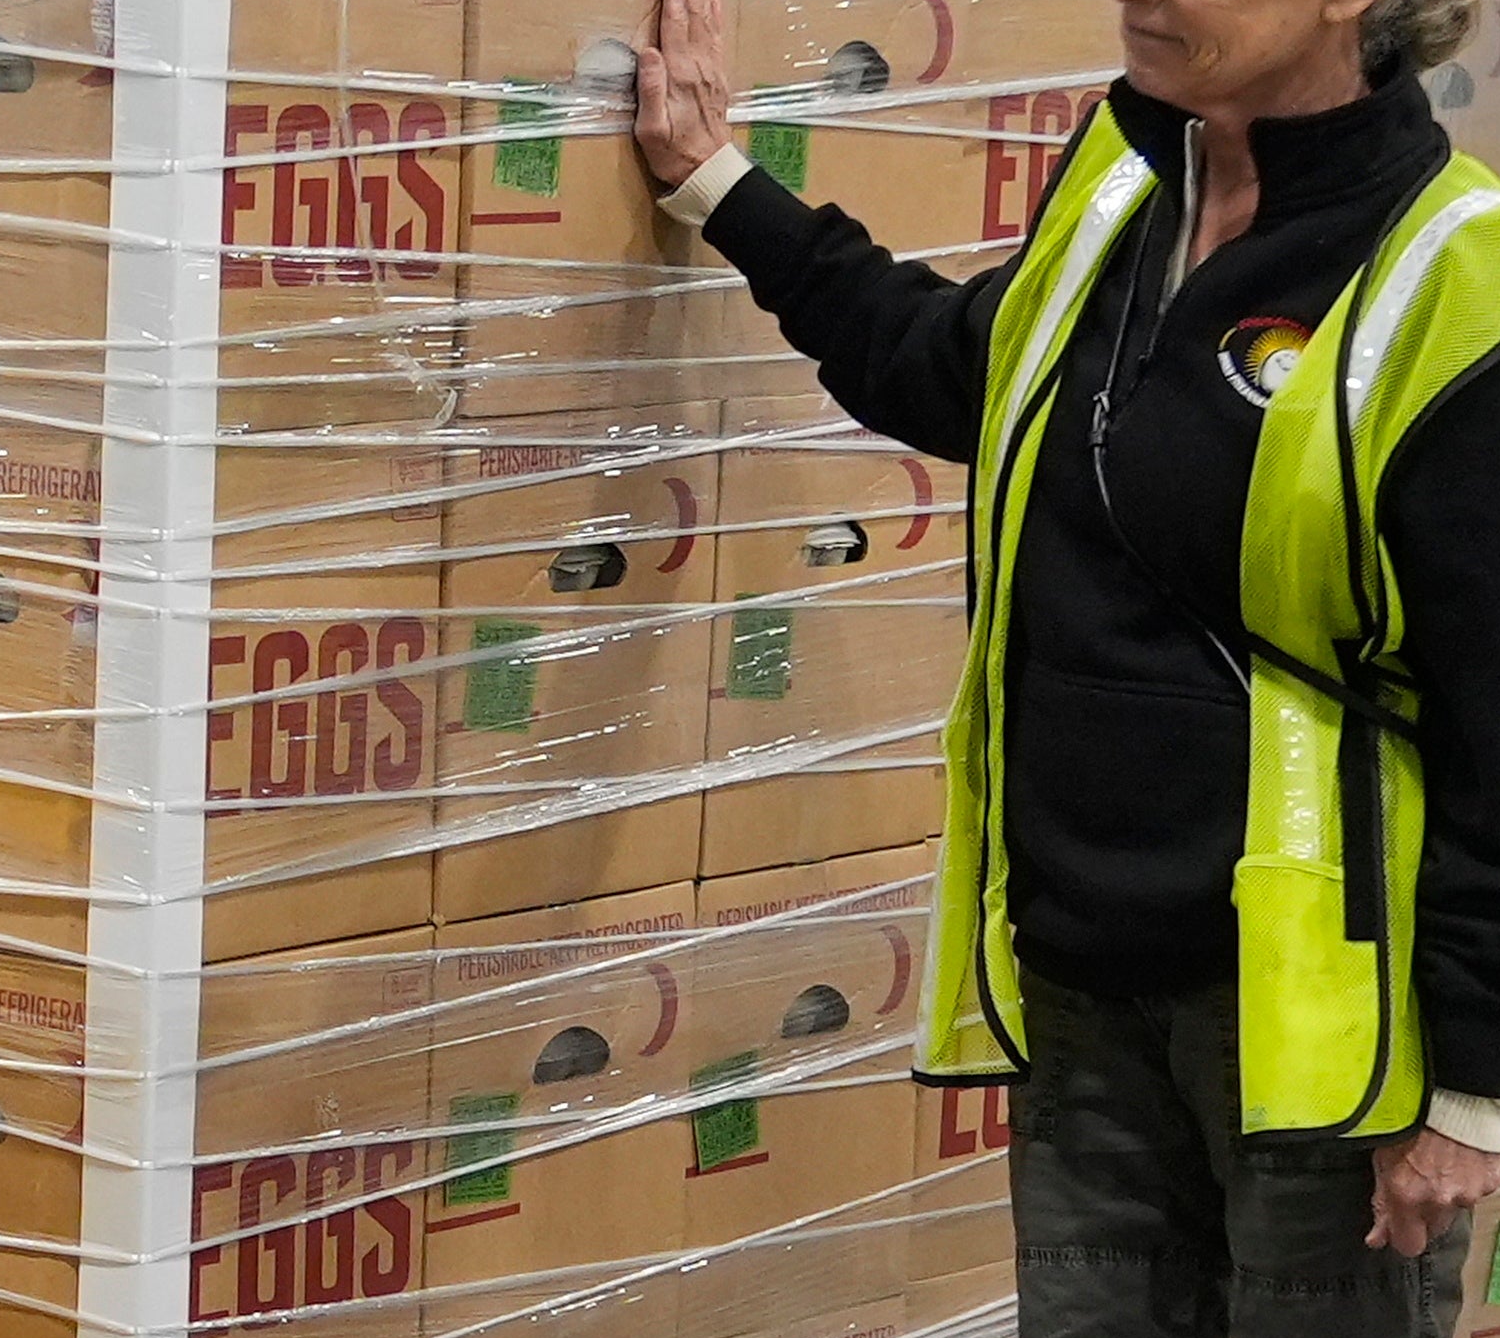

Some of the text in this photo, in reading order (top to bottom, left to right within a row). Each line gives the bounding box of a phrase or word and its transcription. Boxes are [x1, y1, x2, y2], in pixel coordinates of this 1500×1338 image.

[221, 98, 447, 290] EGGS
[981, 93, 1096, 240] EG
[204, 616, 425, 818] EGGS
